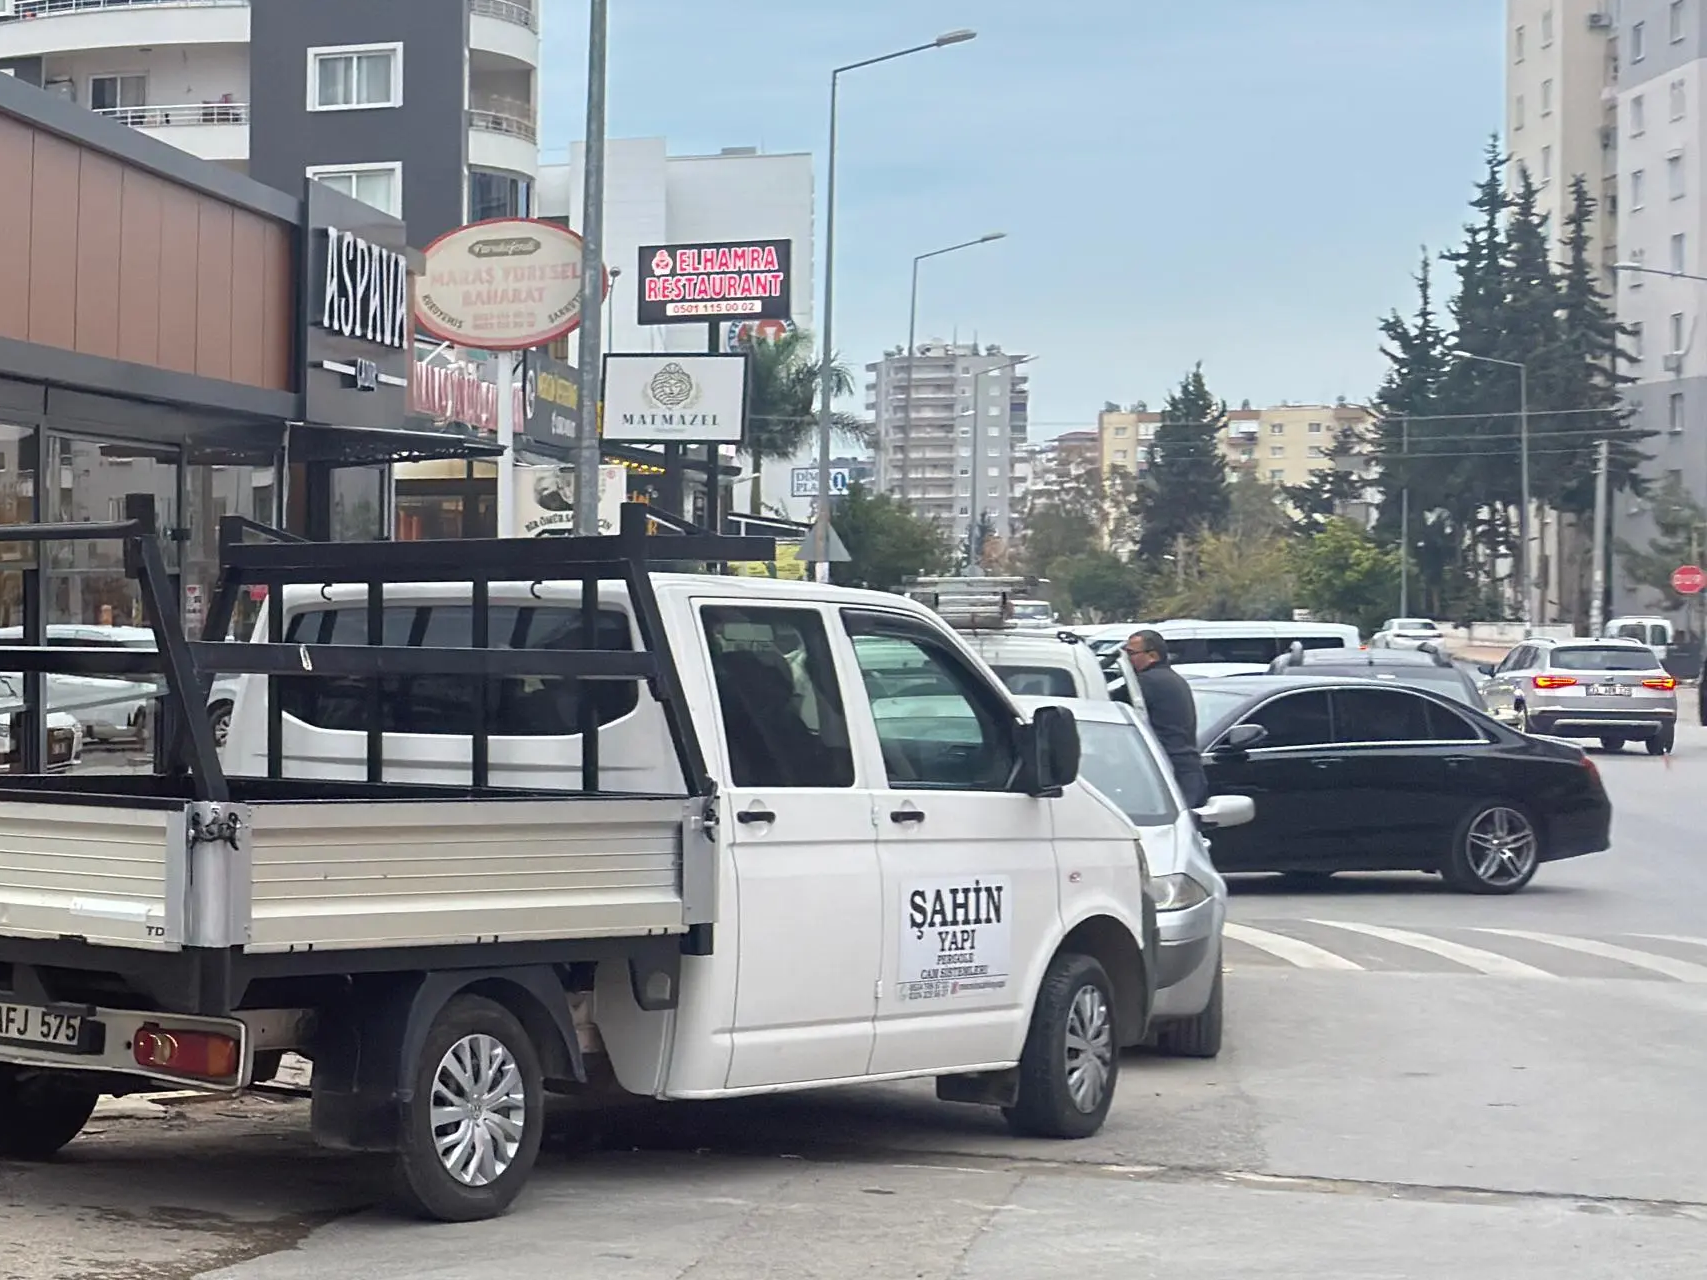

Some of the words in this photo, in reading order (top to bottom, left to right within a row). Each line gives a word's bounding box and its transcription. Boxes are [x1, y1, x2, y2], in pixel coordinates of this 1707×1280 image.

[677, 246, 779, 274] ELHAMRA
[323, 226, 408, 349] ASPAVA
[645, 272, 784, 301] RESTAURANT
[673, 304, 699, 314] 0501
[703, 303, 722, 313] 115
[725, 302, 739, 312] 00
[741, 302, 755, 311] 02
[622, 413, 719, 426] MATMAZEL
[909, 880, 1003, 940] ŞAHİN
[146, 925, 165, 936] TD
[937, 929, 976, 952] YAPI
[920, 969, 939, 979] CAM
[40, 1010, 77, 1041] 575
